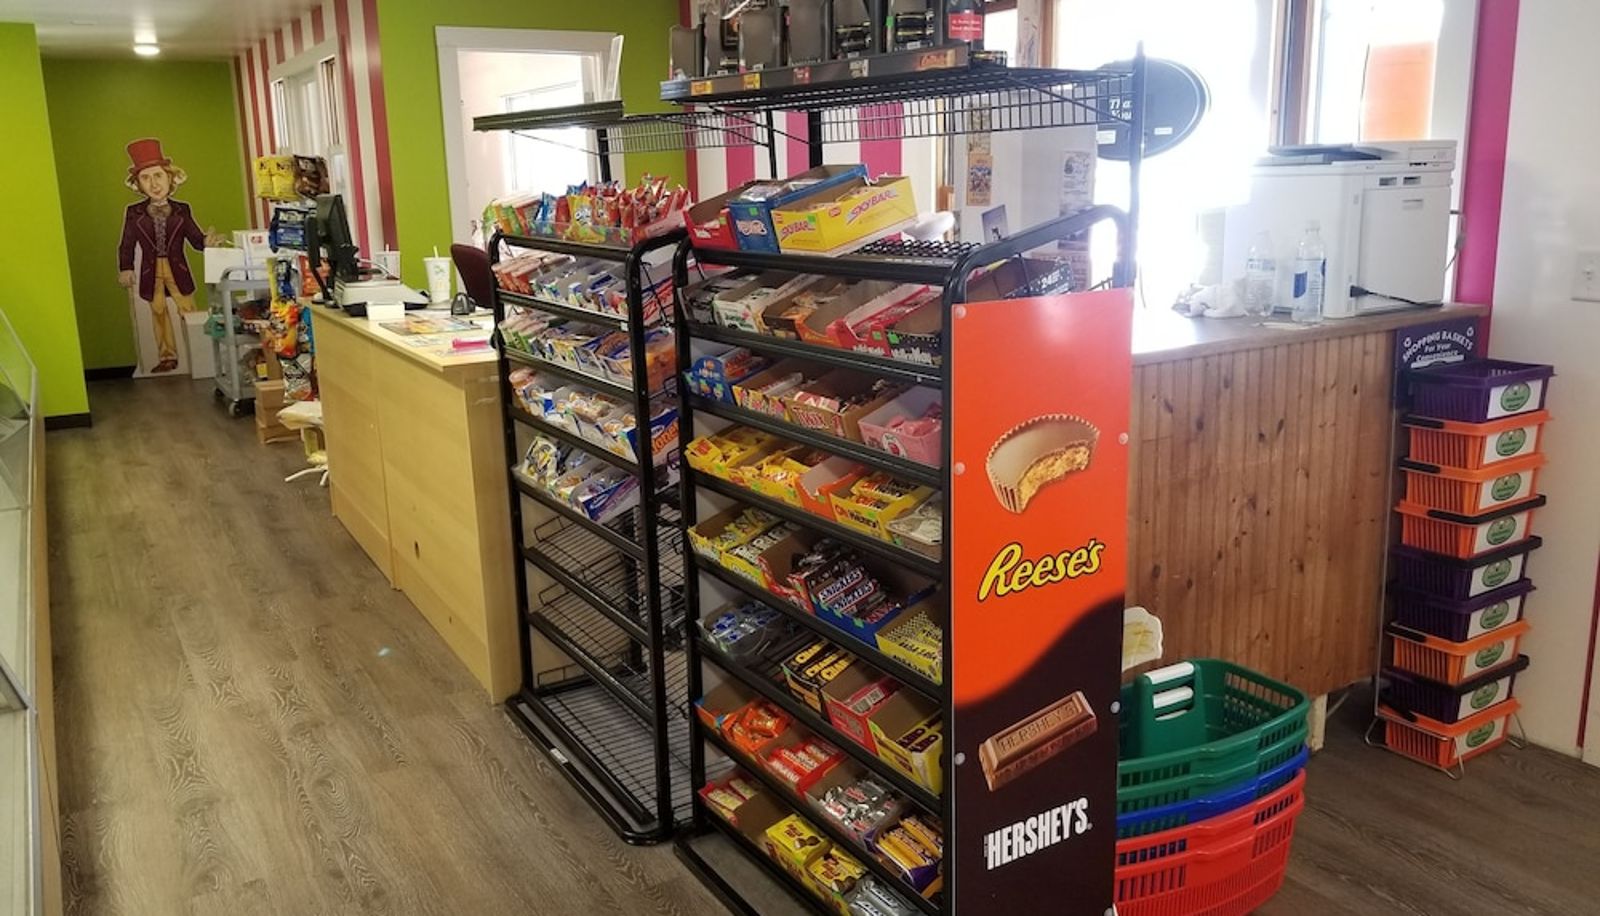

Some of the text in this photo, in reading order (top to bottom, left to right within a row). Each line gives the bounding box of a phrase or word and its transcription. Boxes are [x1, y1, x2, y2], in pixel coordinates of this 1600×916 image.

[1402, 330, 1473, 363] SHOPPING BASKETS
[977, 538, 1105, 602] Reese's
[987, 797, 1089, 871] HERSHEY'S
